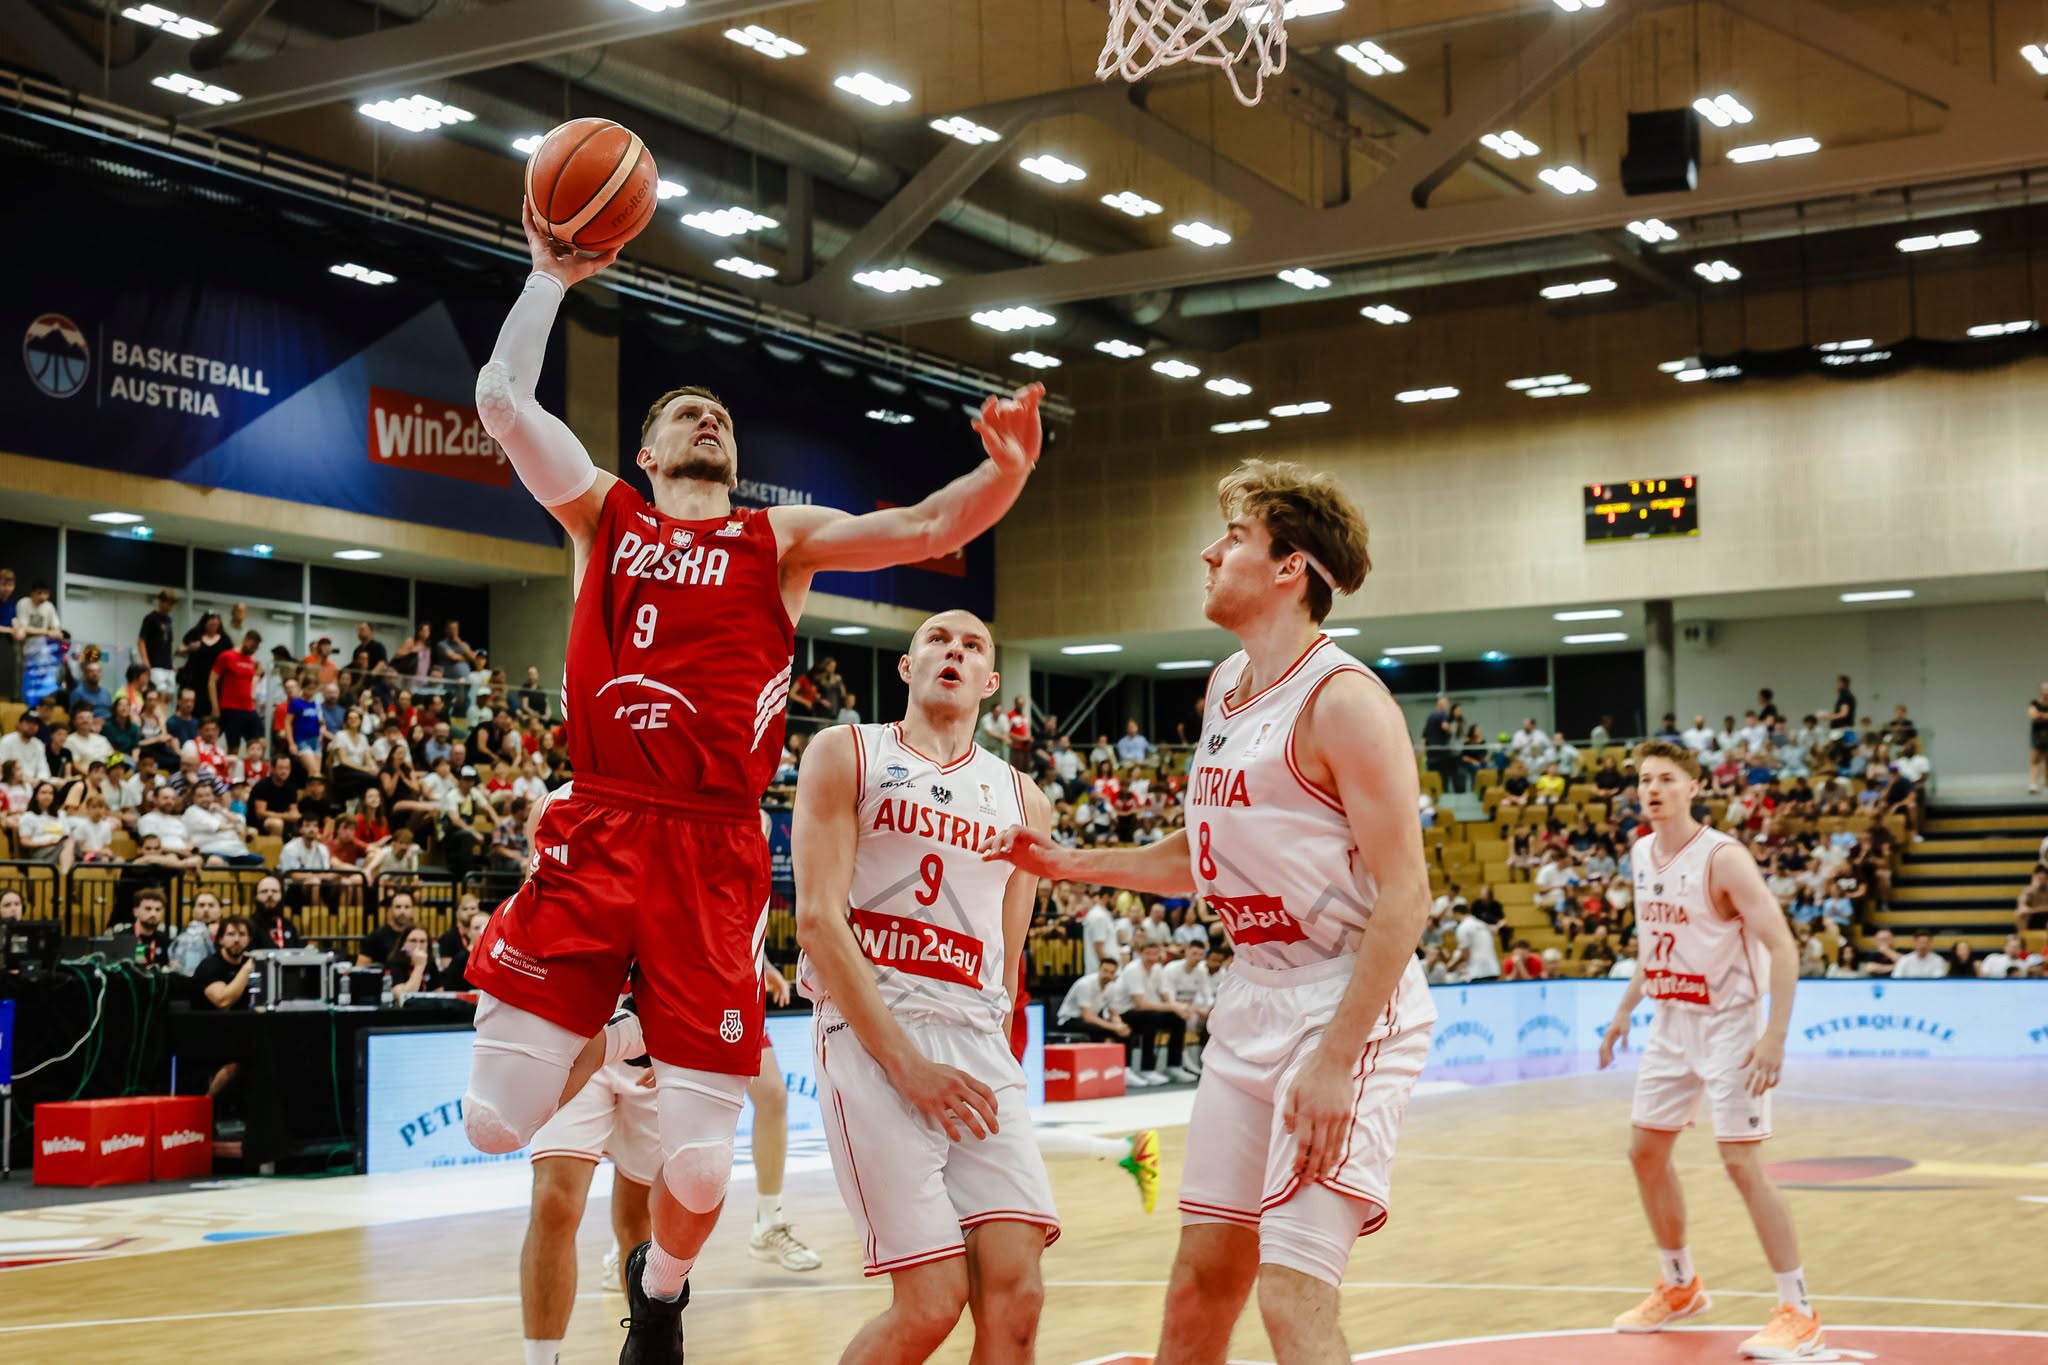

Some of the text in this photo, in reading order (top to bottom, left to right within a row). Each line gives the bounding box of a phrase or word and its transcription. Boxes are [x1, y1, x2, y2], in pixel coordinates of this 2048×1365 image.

[611, 178, 649, 227] molten
[111, 340, 270, 396] BASKETBALL
[109, 376, 220, 418] AUSTRIA
[610, 530, 731, 587] POLSKA
[632, 603, 658, 649] 9
[1193, 765, 1251, 807] STRIA
[1199, 821, 1217, 881] 8
[915, 853, 944, 907] 9
[852, 920, 979, 977] win2day
